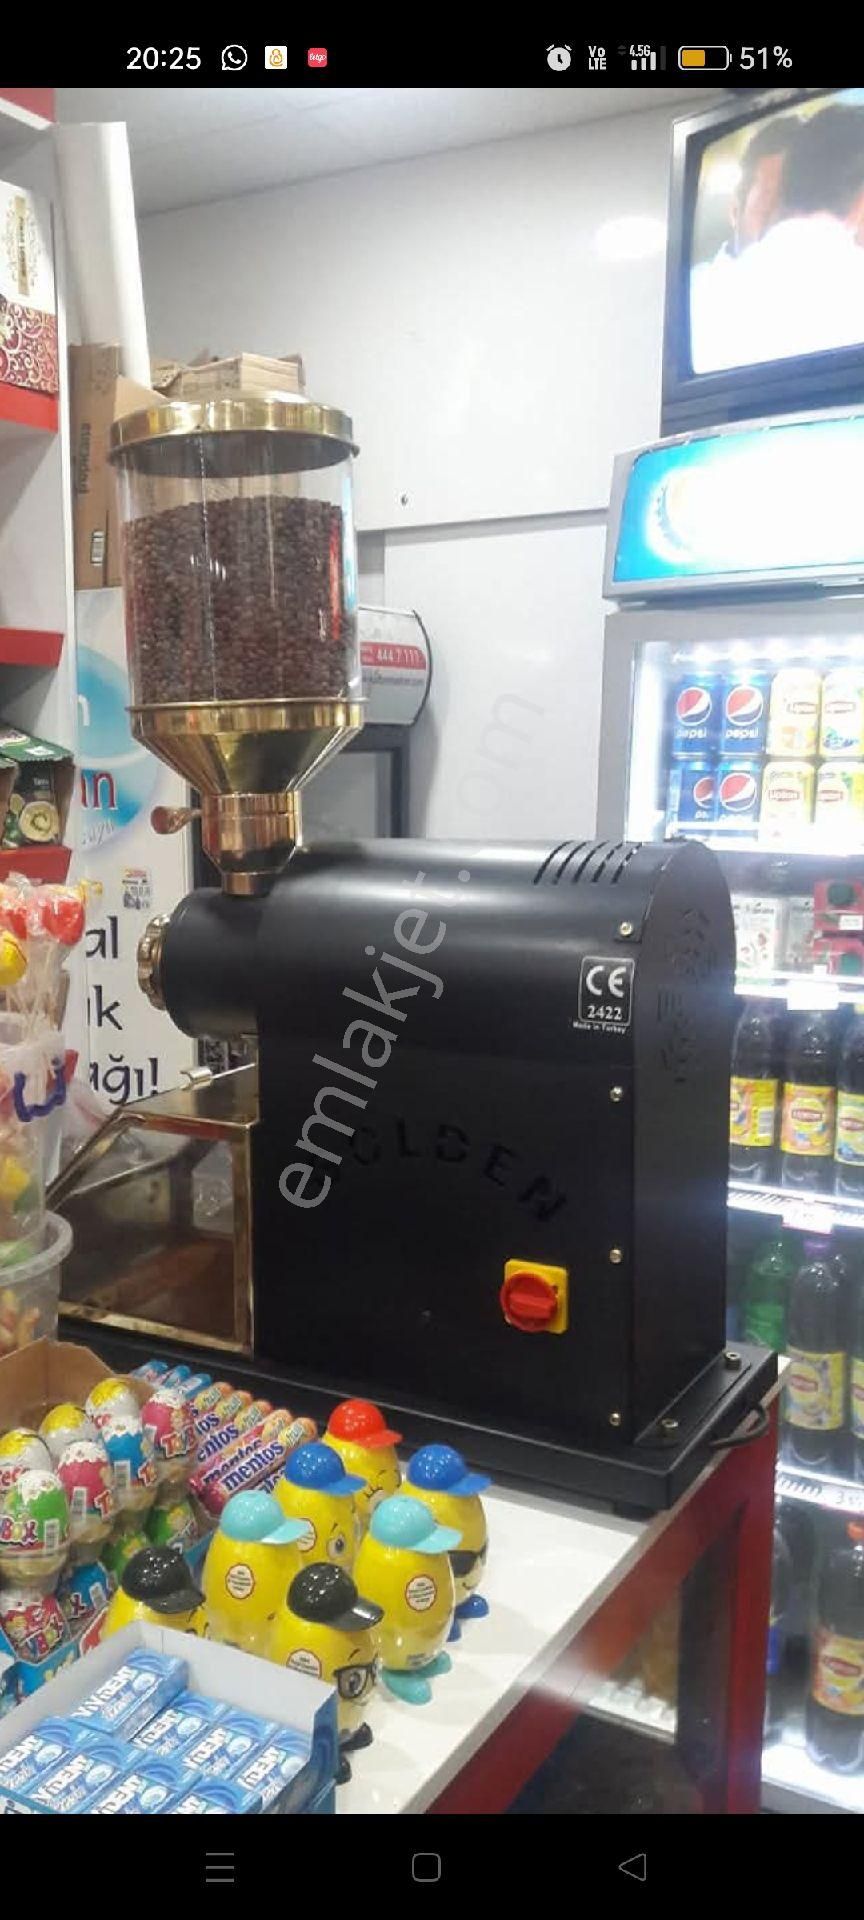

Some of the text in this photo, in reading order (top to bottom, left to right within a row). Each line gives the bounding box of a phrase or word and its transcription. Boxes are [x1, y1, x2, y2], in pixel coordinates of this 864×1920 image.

[585, 965, 627, 998] CE
[586, 1004, 623, 1021] 2422
[601, 1022, 627, 1035] Turkey
[298, 1115, 569, 1223] OLDEN
[197, 1424, 240, 1463] entos
[221, 1440, 285, 1492] mentos
